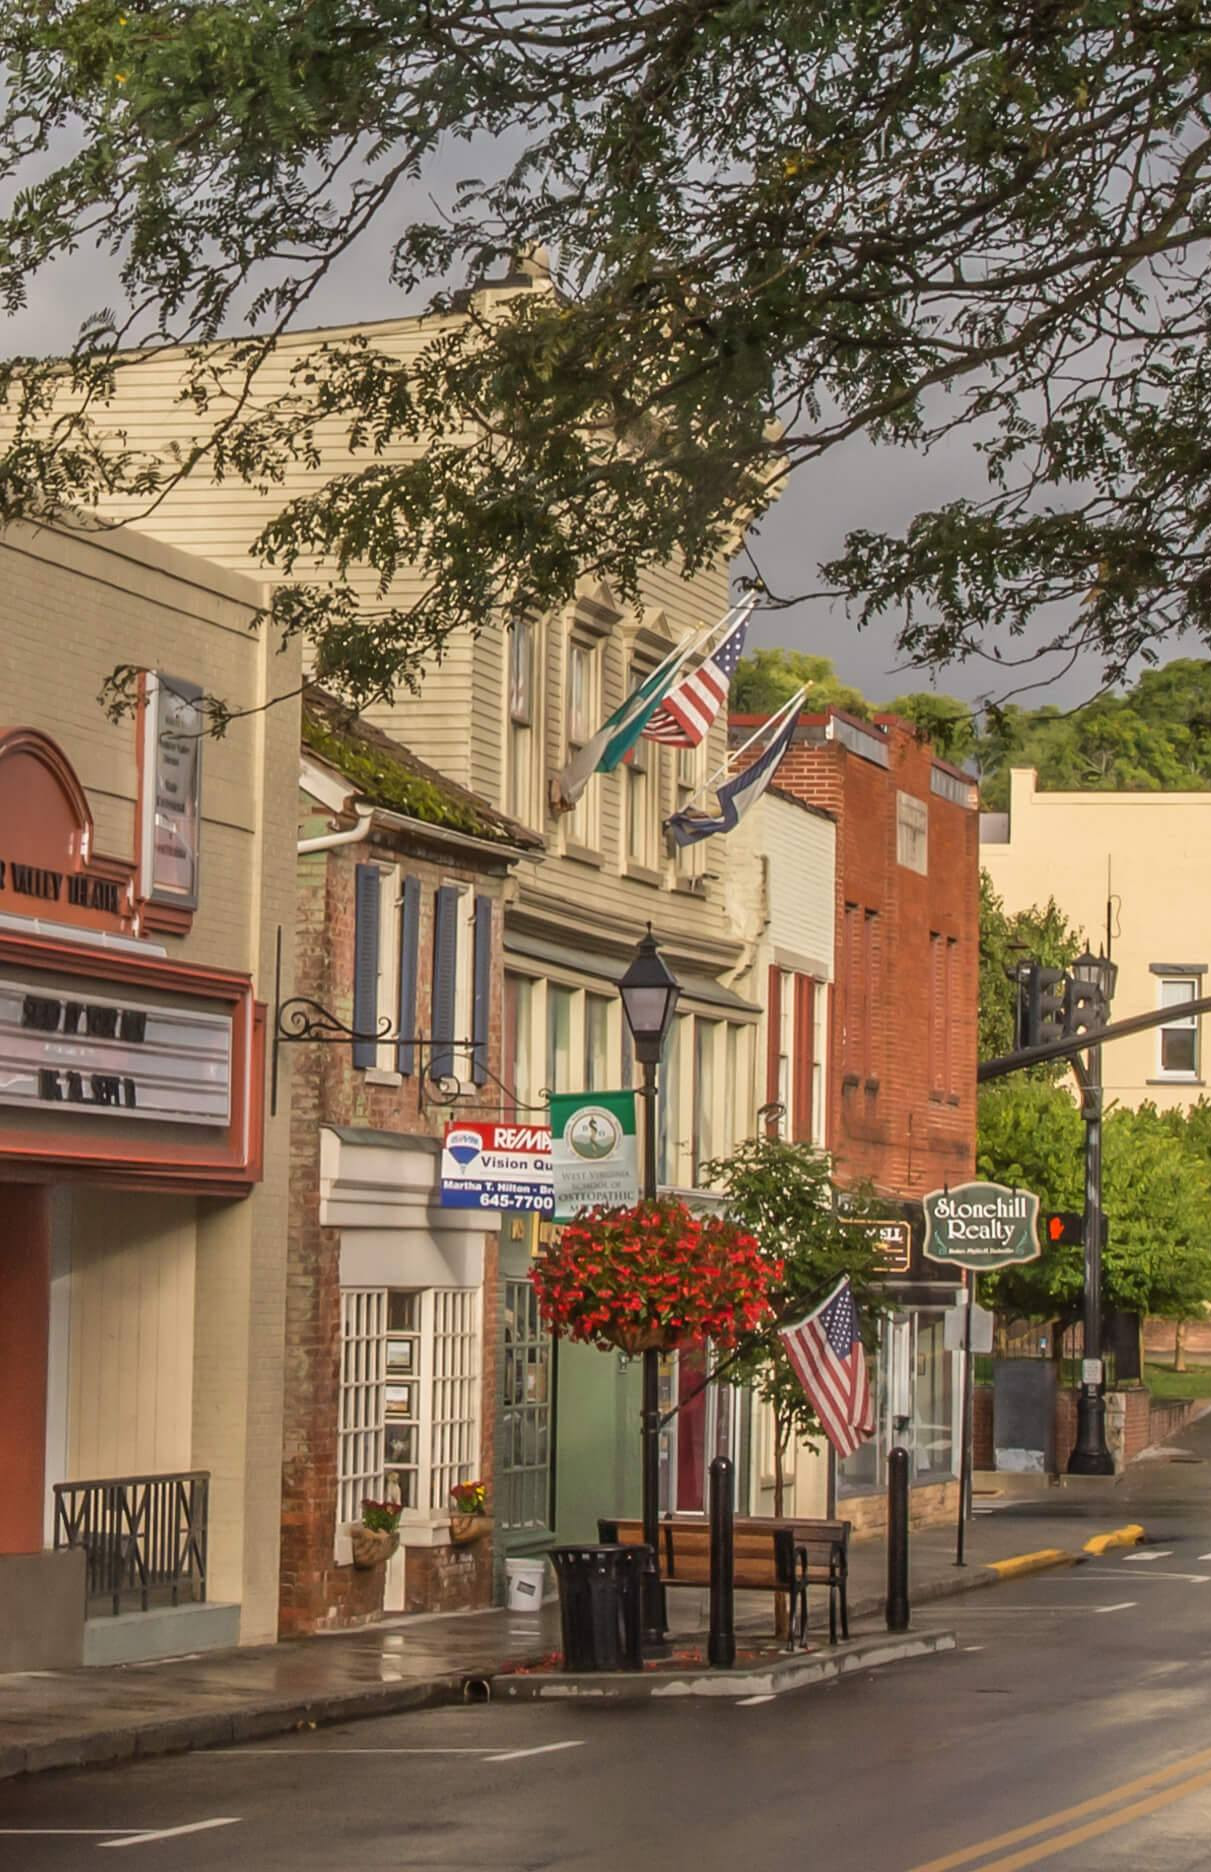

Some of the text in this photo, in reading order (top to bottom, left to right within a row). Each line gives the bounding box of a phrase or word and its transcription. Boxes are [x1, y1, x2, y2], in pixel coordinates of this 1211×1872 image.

[482, 1156, 552, 1171] Vision Qu
[443, 1181, 482, 1190] Martha
[497, 1183, 530, 1193] Hilton
[480, 1193, 553, 1209] 645-7700
[934, 1197, 1026, 1218] Stonehill
[947, 1218, 1015, 1246] Realty
